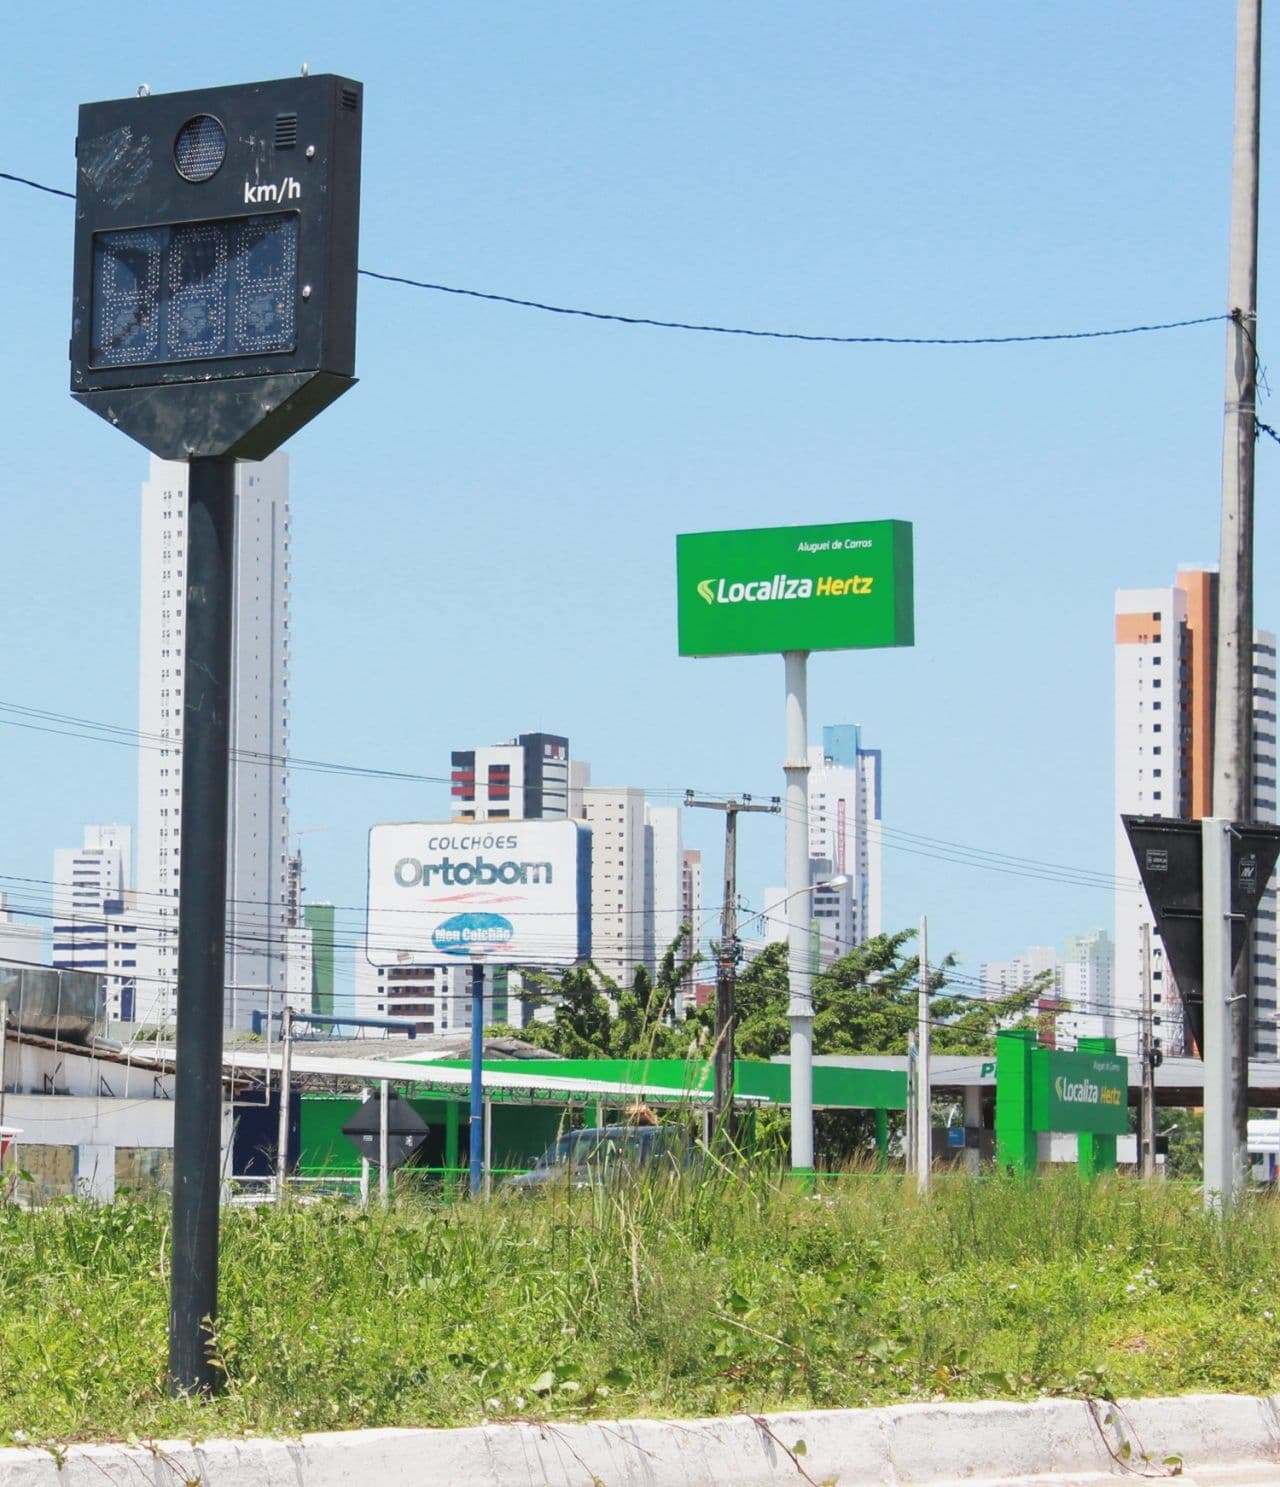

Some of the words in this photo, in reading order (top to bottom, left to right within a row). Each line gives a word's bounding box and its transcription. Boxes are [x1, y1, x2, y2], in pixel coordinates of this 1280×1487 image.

[244, 177, 301, 204] km/h
[797, 540, 830, 553] Aluguel
[831, 539, 842, 550] de
[844, 538, 873, 549] Carros
[717, 574, 813, 603] Localiza
[816, 575, 874, 597] Hertz
[428, 832, 518, 851] COLCHÕES
[394, 856, 553, 888] Ortobom
[1063, 1076, 1099, 1104] Localiza
